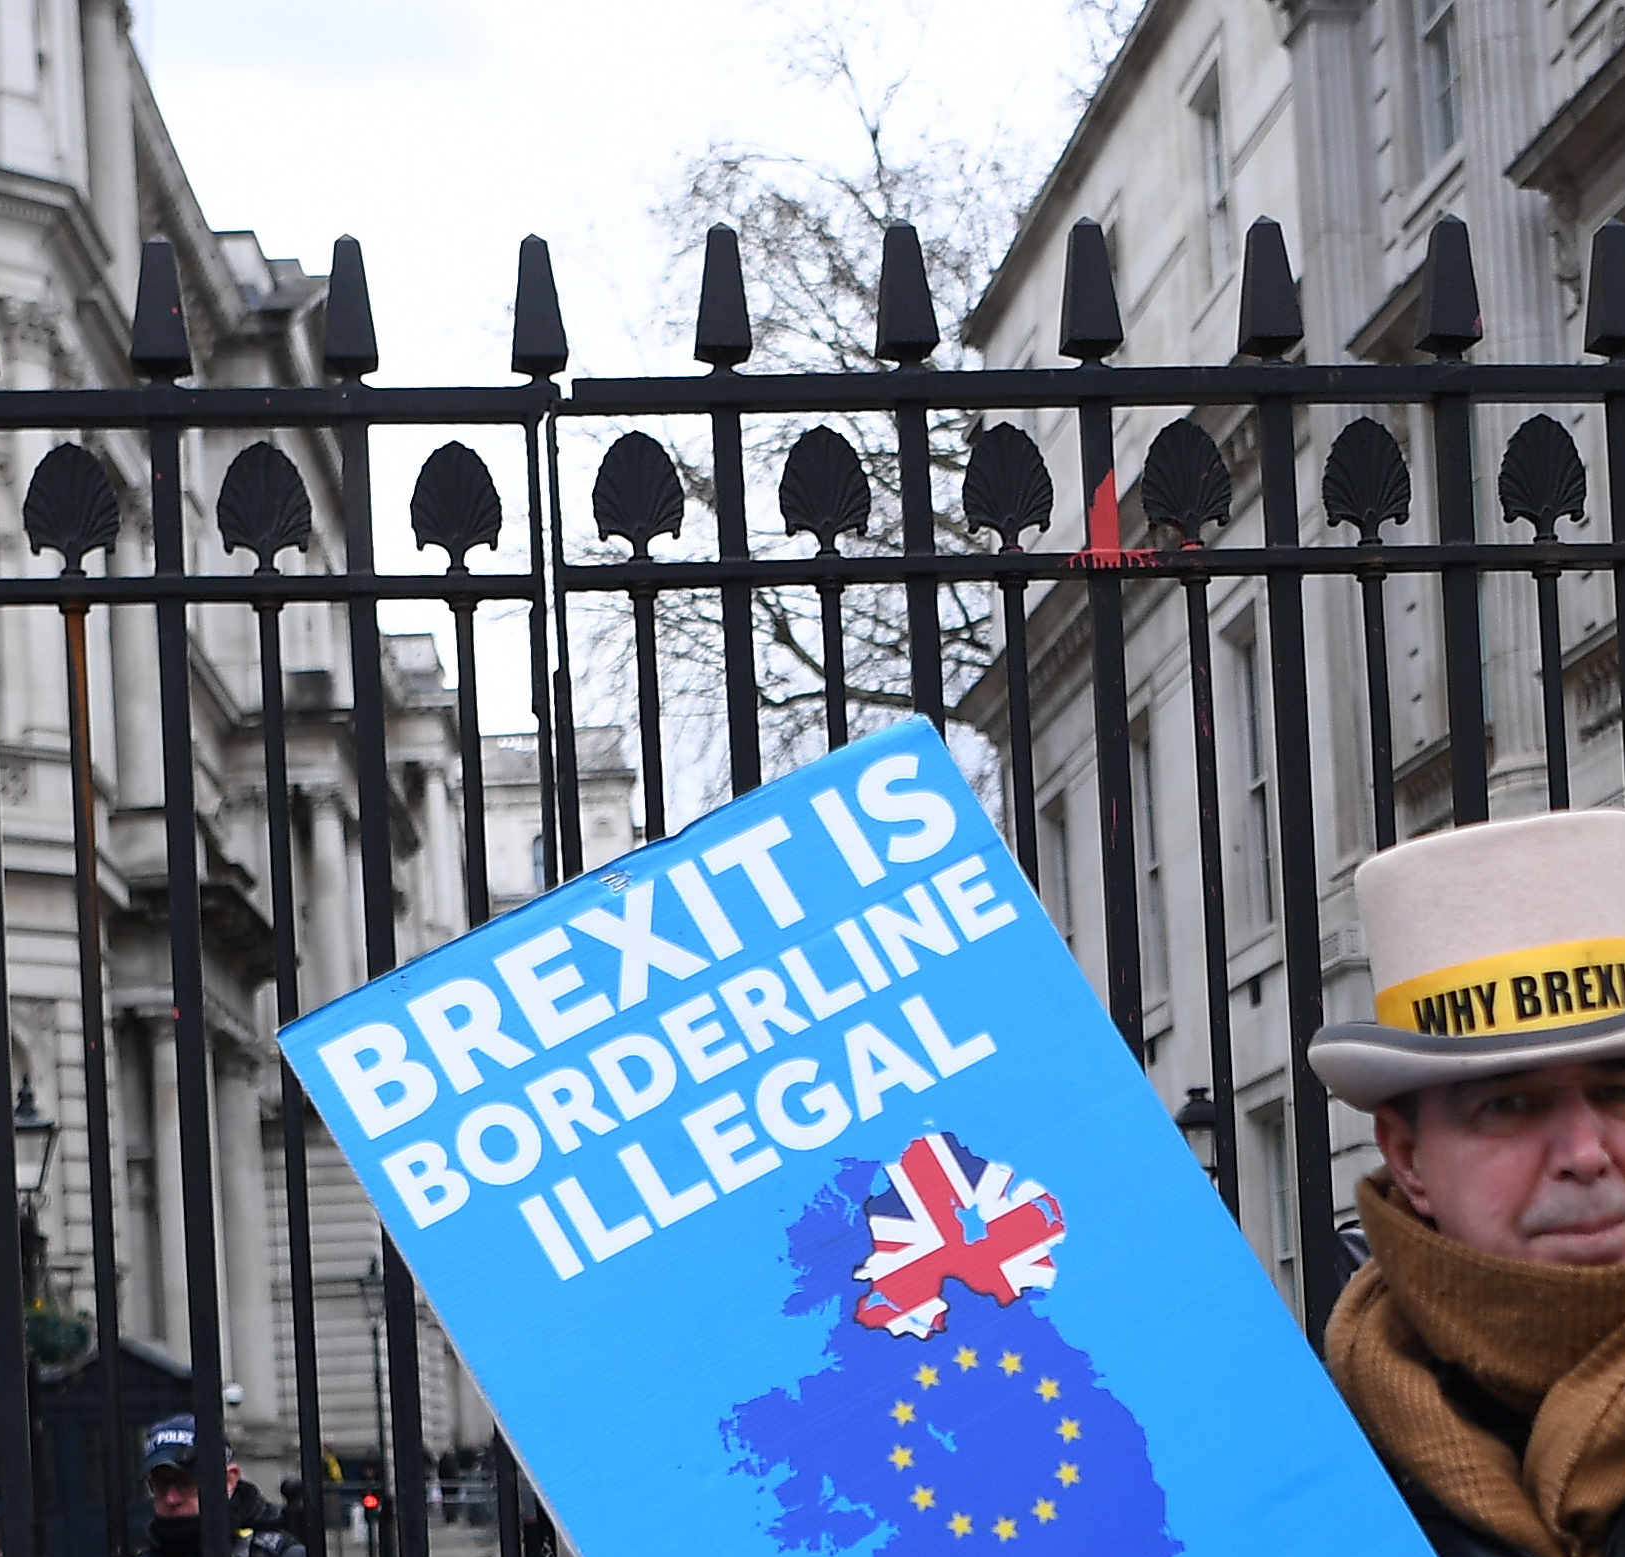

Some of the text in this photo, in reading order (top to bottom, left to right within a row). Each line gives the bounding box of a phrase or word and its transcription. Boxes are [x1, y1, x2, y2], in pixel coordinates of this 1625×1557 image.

[319, 756, 957, 1139] BREXIT IS
[381, 855, 1018, 1230] BORDERLINE
[1411, 982, 1497, 1036] WHY
[519, 996, 997, 1281] ILLEGAL
